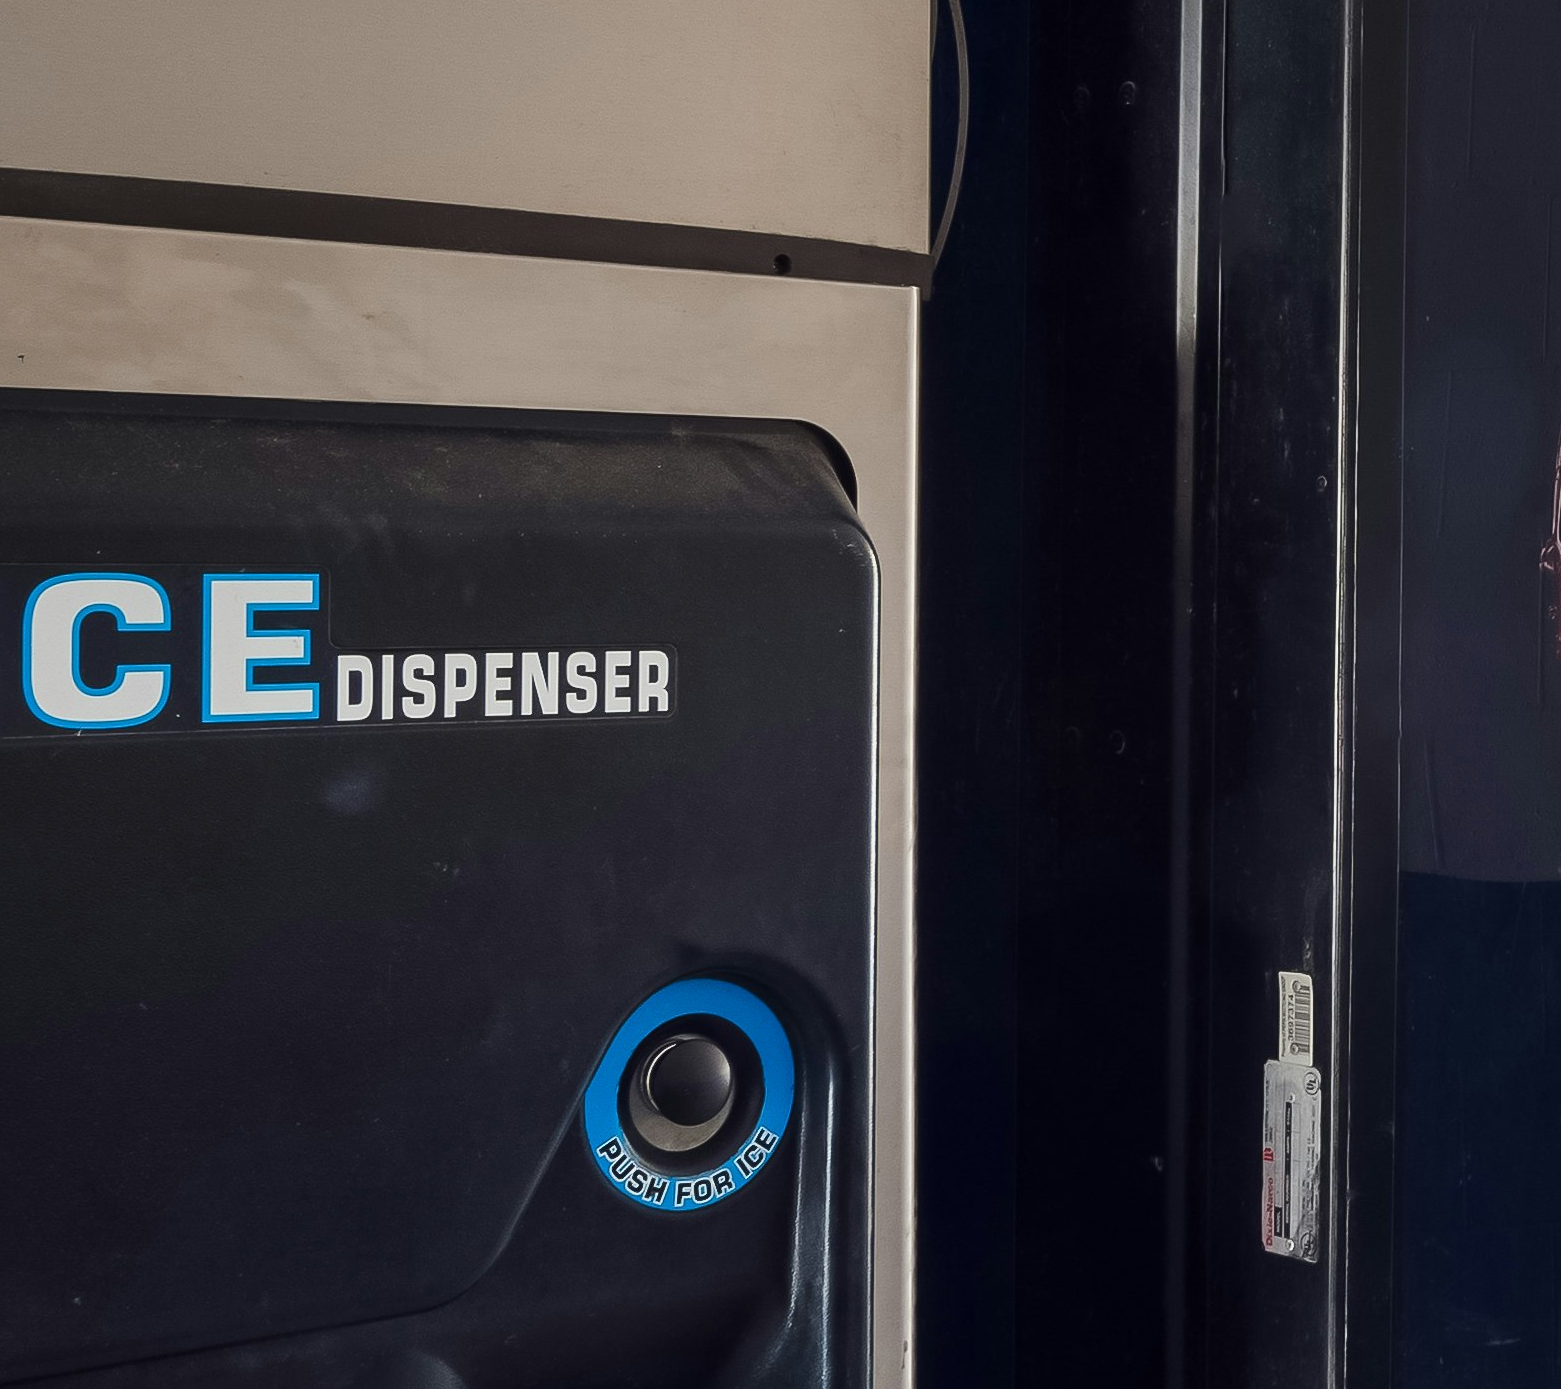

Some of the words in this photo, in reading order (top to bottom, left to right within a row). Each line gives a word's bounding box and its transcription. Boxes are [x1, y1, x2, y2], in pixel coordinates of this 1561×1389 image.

[336, 649, 671, 723] DISPENSER
[596, 1135, 670, 1206] PUSH
[674, 1168, 736, 1208] FOR
[733, 1126, 780, 1180] ICE
